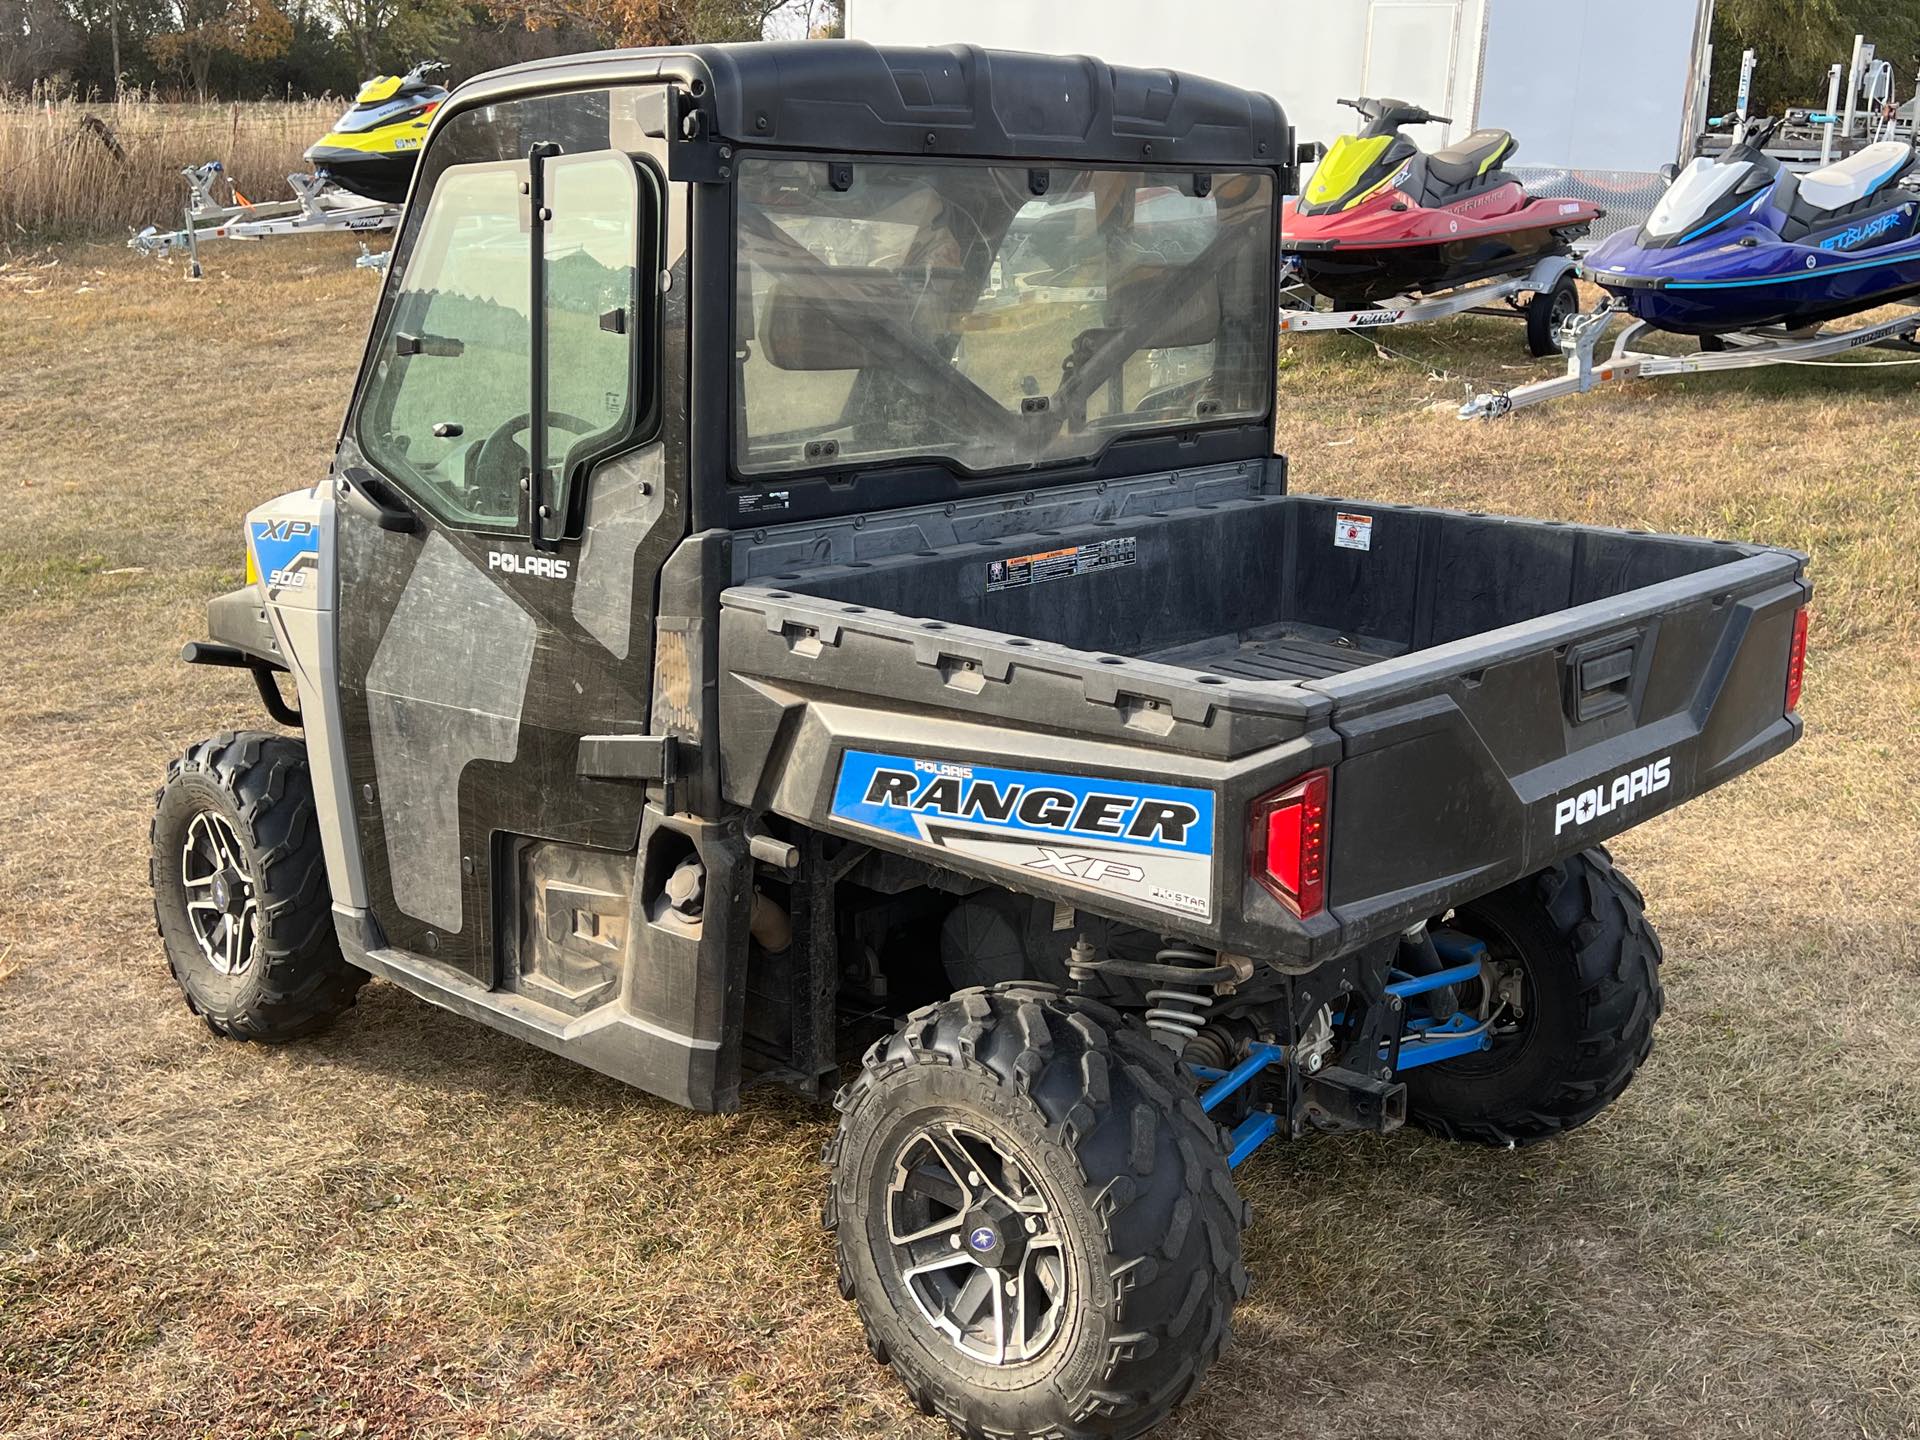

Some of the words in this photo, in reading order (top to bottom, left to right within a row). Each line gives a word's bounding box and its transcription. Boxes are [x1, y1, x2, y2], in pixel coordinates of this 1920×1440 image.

[1355, 310, 1400, 322] TRITON
[257, 519, 312, 542] XP
[488, 551, 569, 579] POLARIS
[269, 570, 306, 587] 900
[914, 761, 973, 779] POLARIS
[863, 768, 1200, 844] RANGER
[1554, 756, 1672, 836] POLARIS
[1023, 847, 1146, 882] XP
